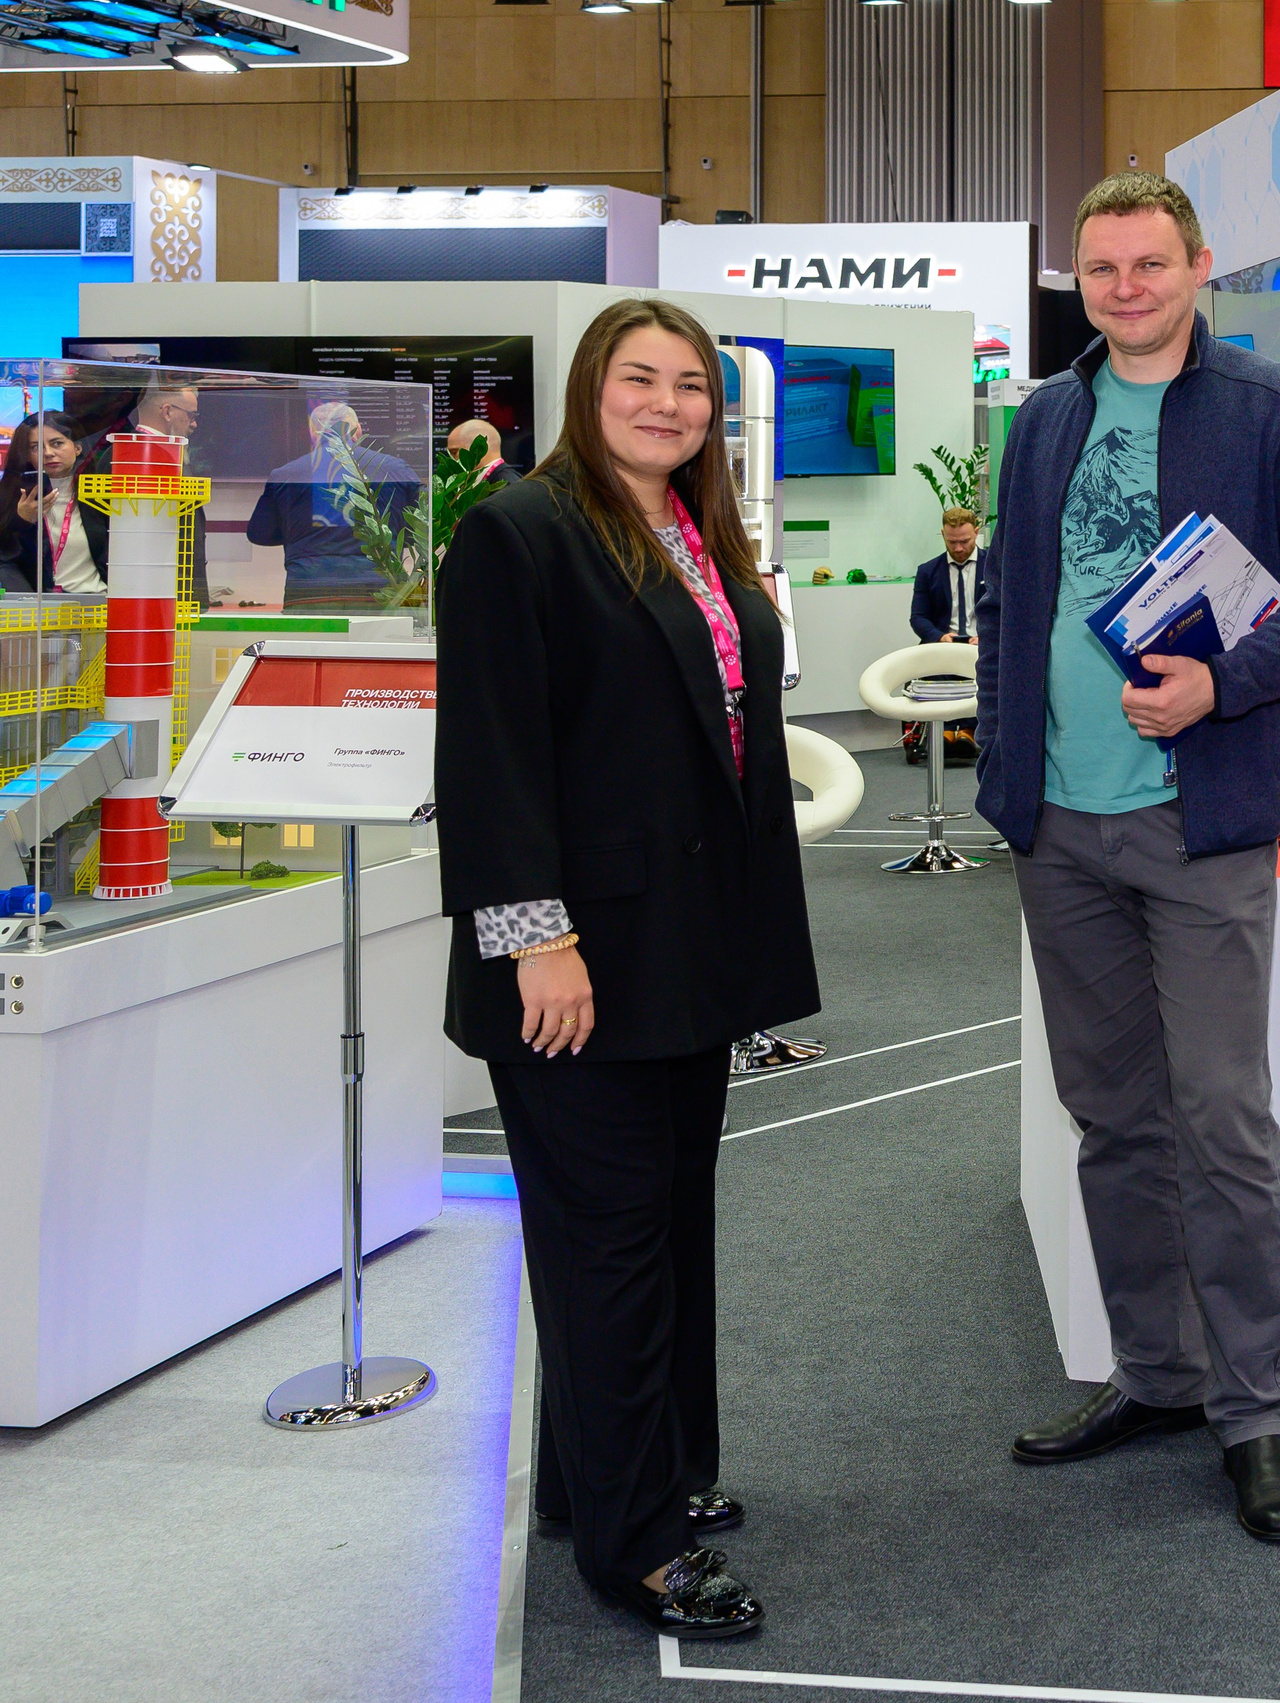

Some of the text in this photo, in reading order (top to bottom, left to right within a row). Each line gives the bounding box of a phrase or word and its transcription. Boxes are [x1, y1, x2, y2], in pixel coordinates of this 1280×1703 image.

[752, 257, 932, 290] НАМИ
[341, 700, 421, 709] ТЕХНОЛОГИИ
[247, 752, 305, 762] ФИНГО
[333, 748, 405, 757] Группа «ФИНГО»
